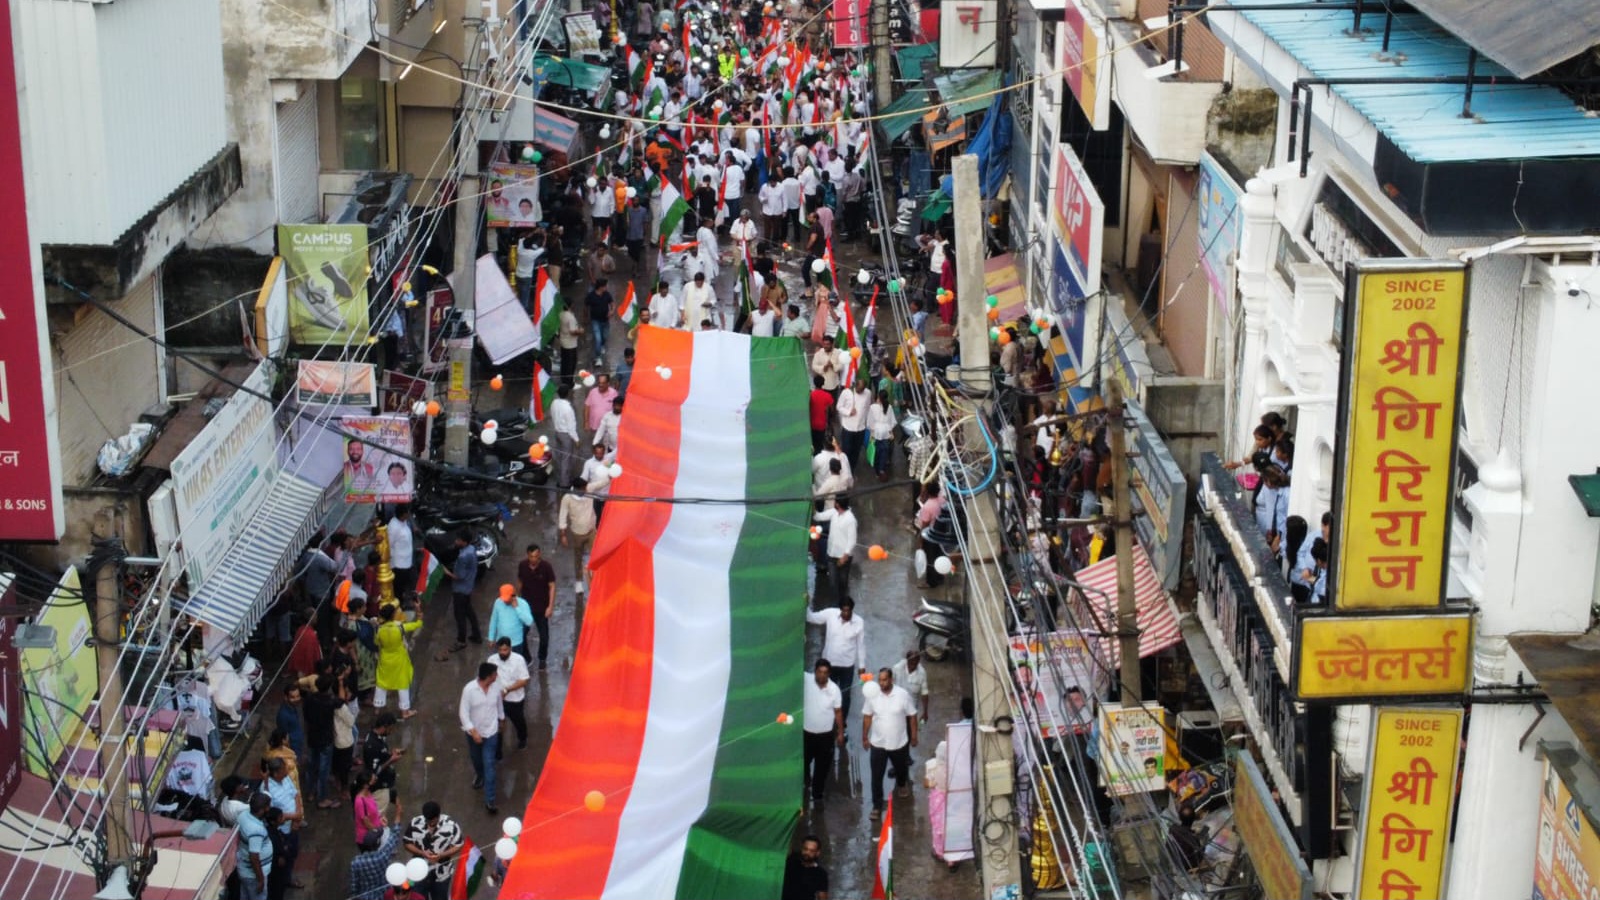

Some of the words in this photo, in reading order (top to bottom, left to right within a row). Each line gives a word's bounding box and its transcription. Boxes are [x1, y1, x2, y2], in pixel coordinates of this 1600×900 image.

[293, 232, 353, 245] CAMPUS
[1385, 279, 1446, 293] SINCE
[1392, 297, 1436, 311] 2002
[1378, 321, 1445, 376] श्री
[182, 456, 213, 510] VIKAS
[16, 499, 47, 510] SONS
[1314, 630, 1458, 681] ज्वैलर्स
[1395, 718, 1441, 731] SINCE
[1400, 735, 1434, 747] 2002
[1387, 757, 1438, 805] श्री
[1556, 830, 1589, 900] SHREE
